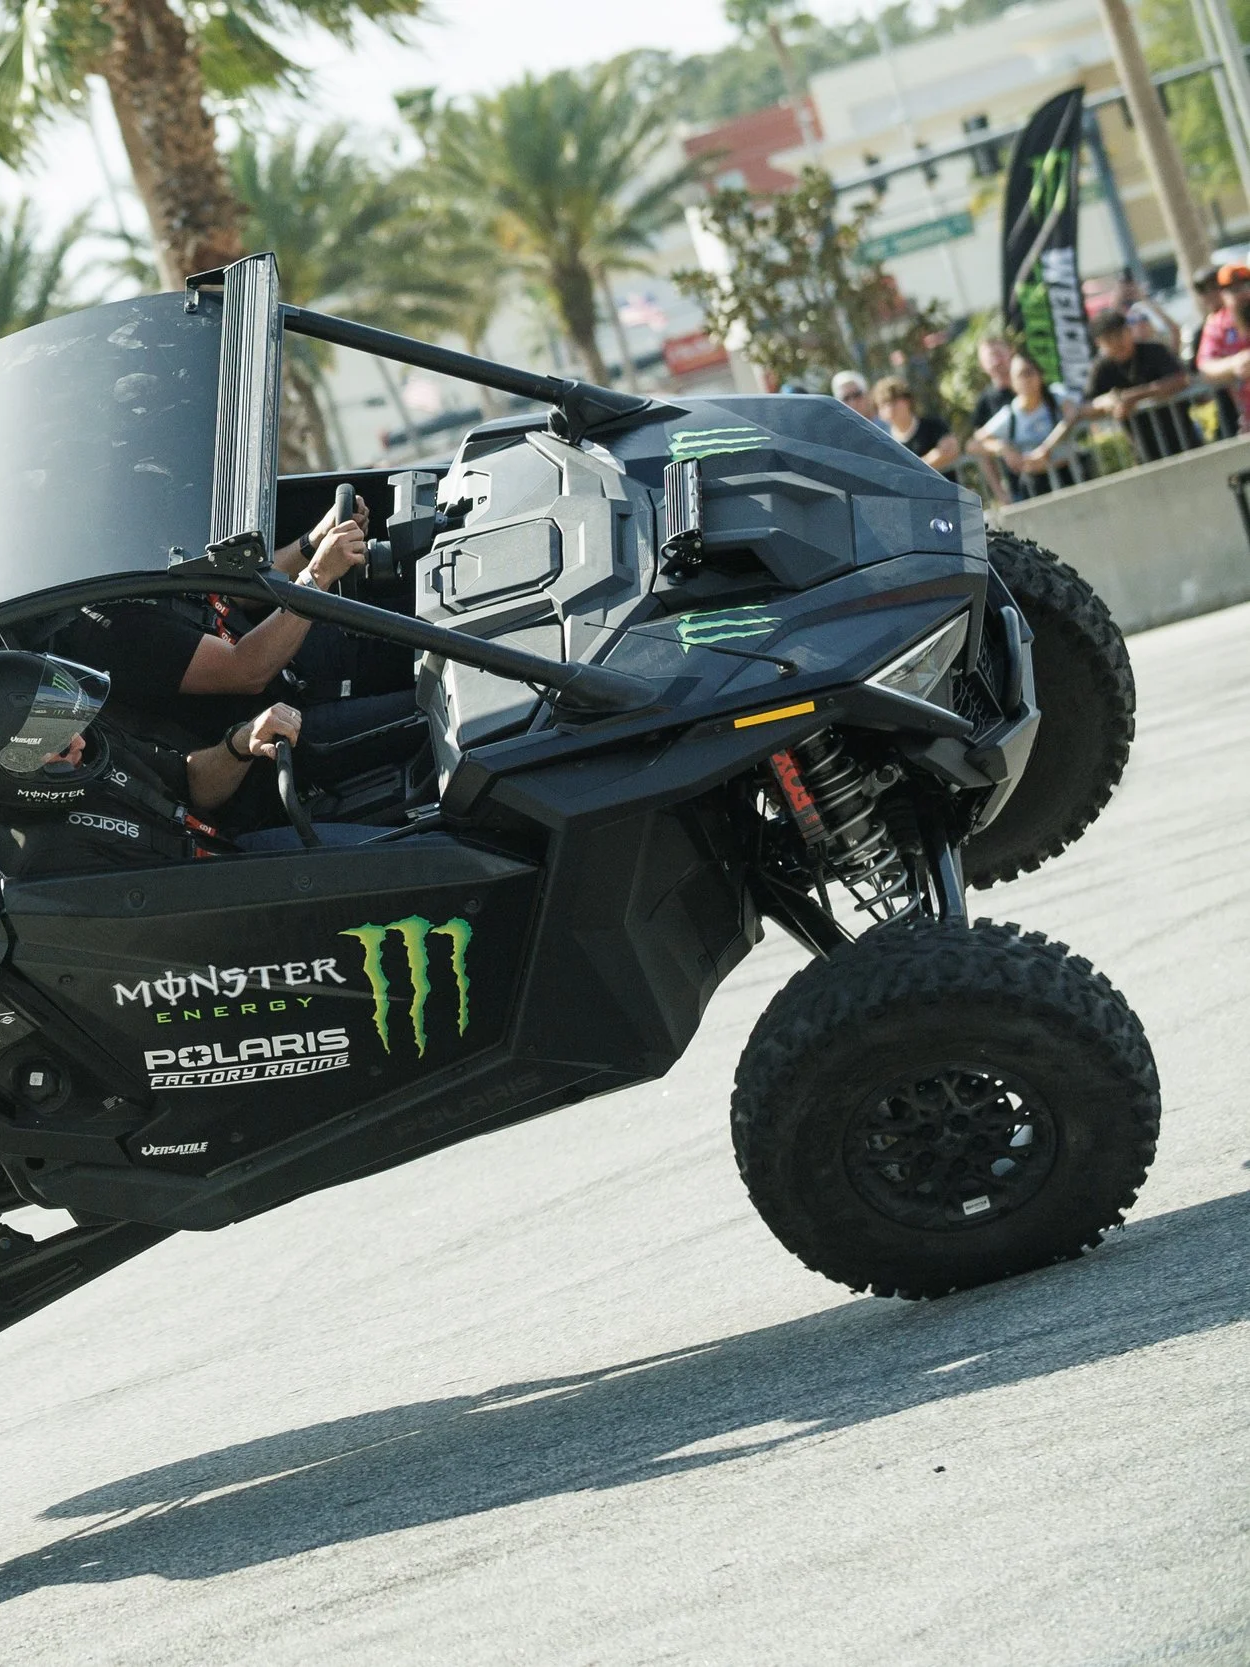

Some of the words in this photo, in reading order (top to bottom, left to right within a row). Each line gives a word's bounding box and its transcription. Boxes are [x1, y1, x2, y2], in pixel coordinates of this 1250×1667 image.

[17, 788, 85, 800] MONSTER
[69, 812, 140, 838] sparco
[112, 957, 347, 1008] MONSTER
[156, 996, 313, 1024] ENERGY
[143, 1027, 350, 1070] POLARIS
[150, 1068, 257, 1087] FACTORY
[264, 1055, 350, 1077] RACING
[141, 1141, 209, 1156] VERSATILE
